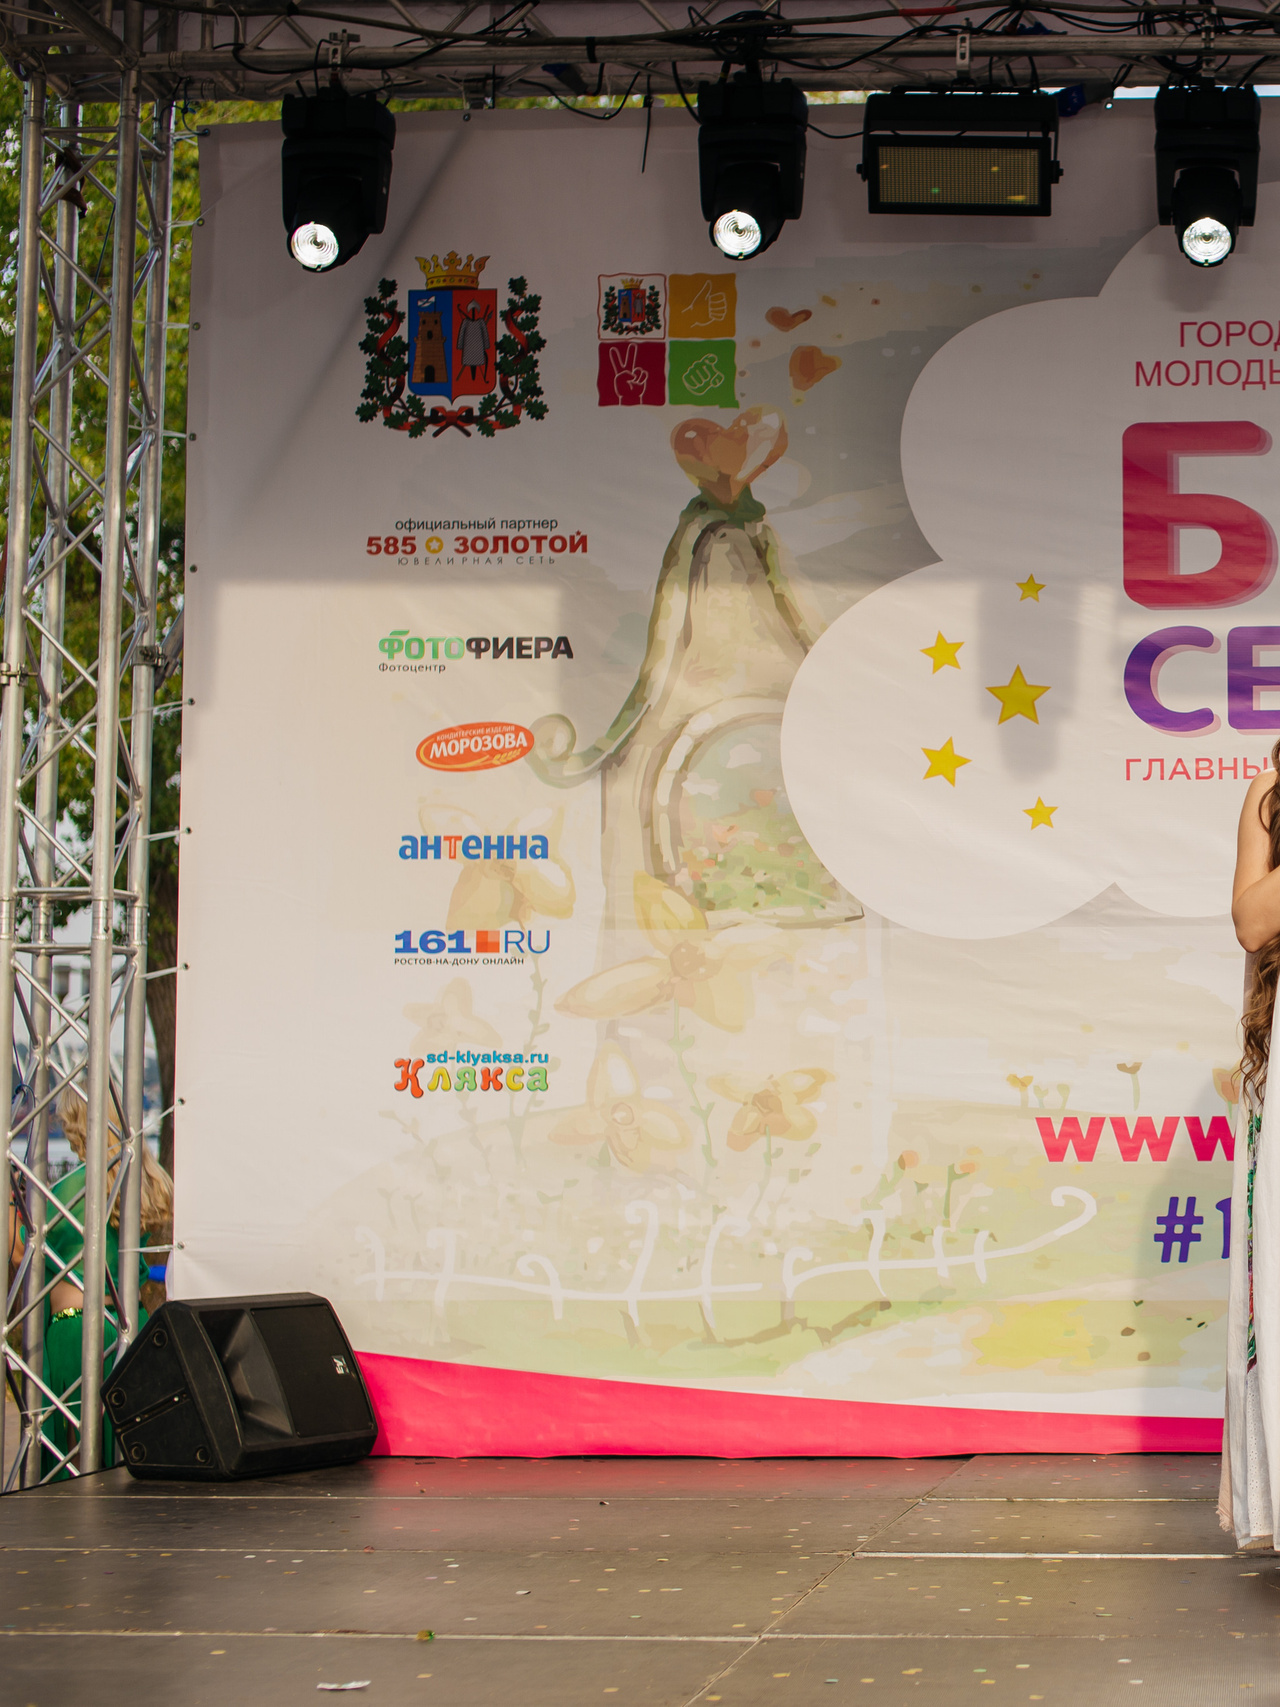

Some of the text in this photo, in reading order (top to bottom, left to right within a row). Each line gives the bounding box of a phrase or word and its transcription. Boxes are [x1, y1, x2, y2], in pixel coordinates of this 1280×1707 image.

[395, 517, 559, 533] официальный партнер
[366, 529, 589, 556] 585 ЗОЛОТОЙ
[397, 556, 556, 566] ЮВЕЛИРНАЯ СЕТЬ
[378, 629, 575, 661] ФОТОФИЕРА
[378, 662, 447, 674] Фотоцентр
[436, 725, 515, 741] КОНДИТЕРСКИЕ ИЗДЕЛИЯ
[429, 731, 528, 760] МОРОЗОВА
[1124, 756, 1269, 781] ГЛАВНЫ
[398, 834, 549, 861] антенна
[394, 957, 525, 967] РОСТОВ-НА-ДОНУ ОНЛАЙН
[425, 1050, 549, 1067] sd-klyaksa.ru
[393, 1057, 549, 1099] Клякса
